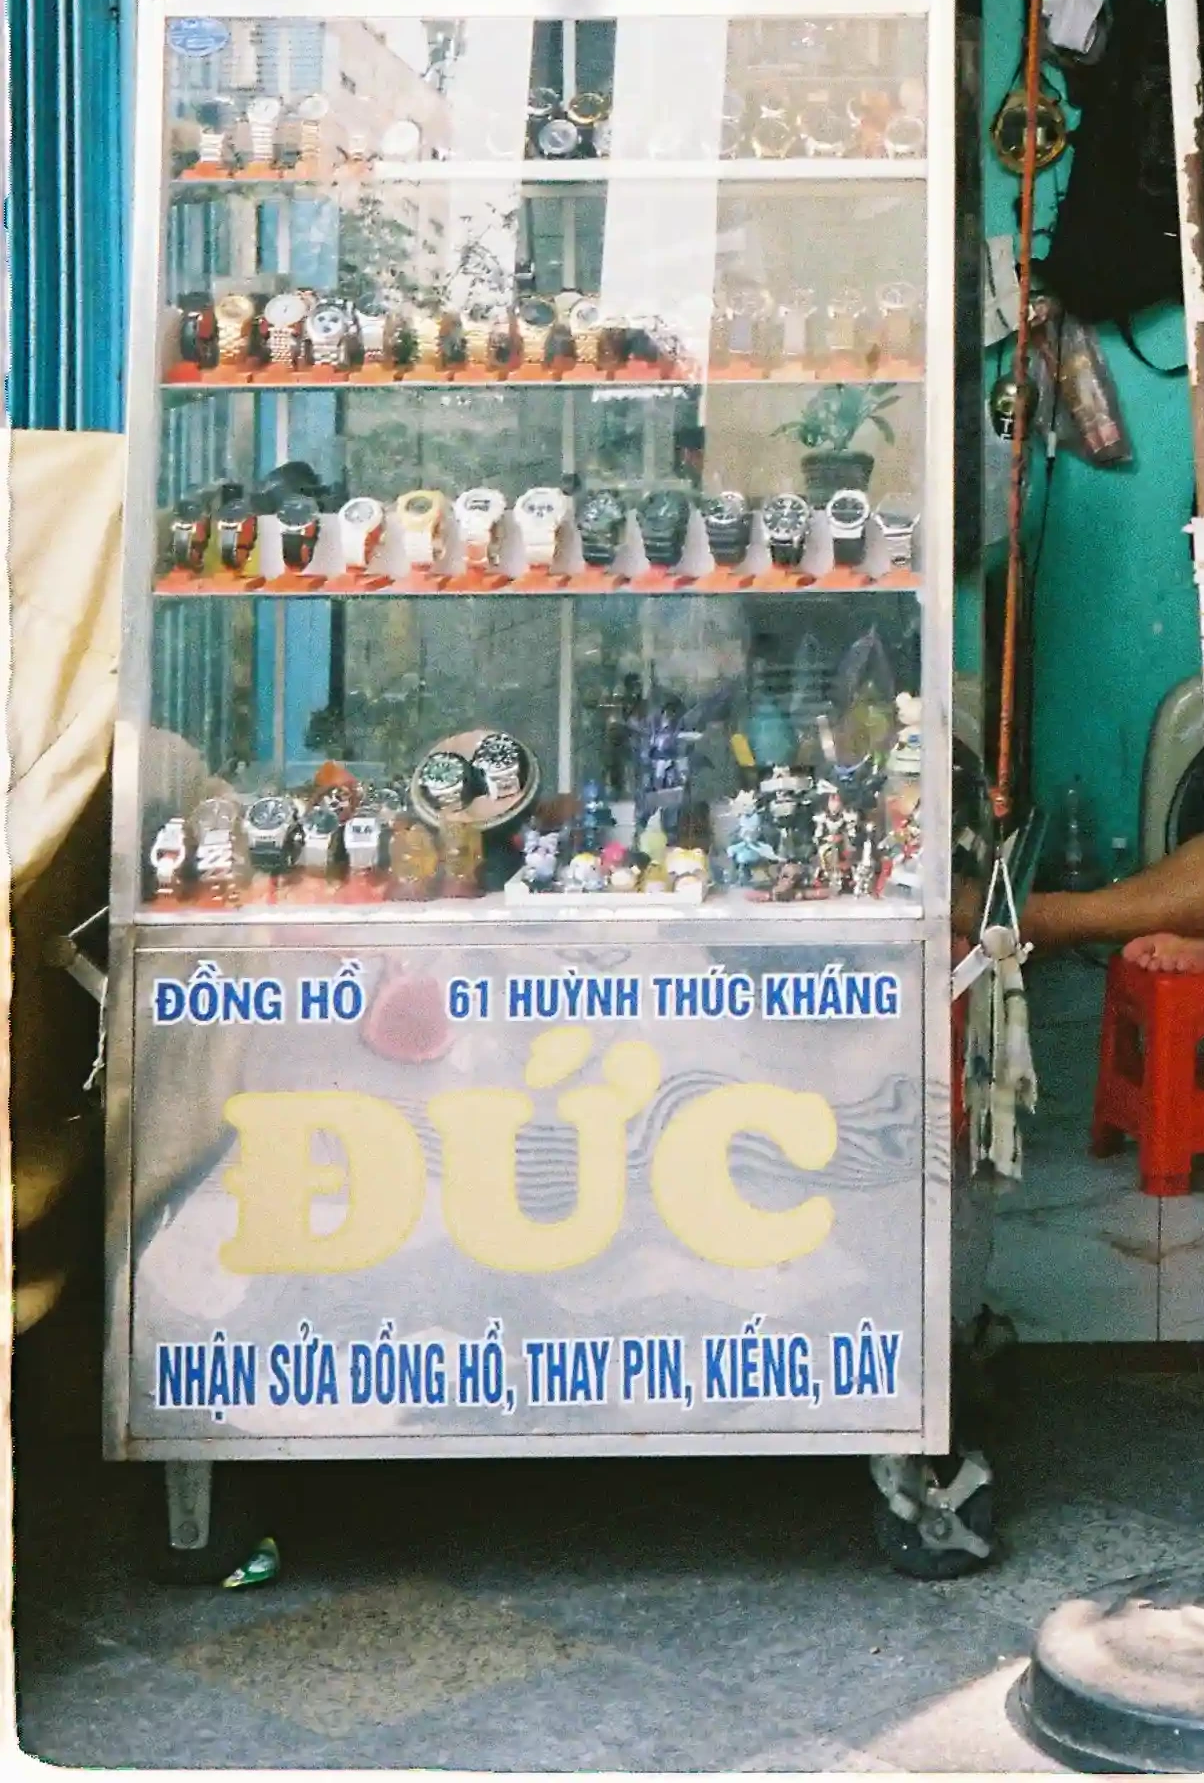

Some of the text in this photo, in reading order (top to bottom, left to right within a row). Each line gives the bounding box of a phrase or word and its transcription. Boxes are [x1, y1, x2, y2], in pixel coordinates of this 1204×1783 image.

[155, 962, 364, 1021] ĐỒNG HỒ
[447, 967, 898, 1018] 61 HUỲNH THÚC KHÁNG
[218, 1025, 839, 1275] ĐỨC
[158, 1316, 901, 1421] NHẬN SỬA ĐỒNG HỒ, THAY PIN, KIẾNG, DÂY
